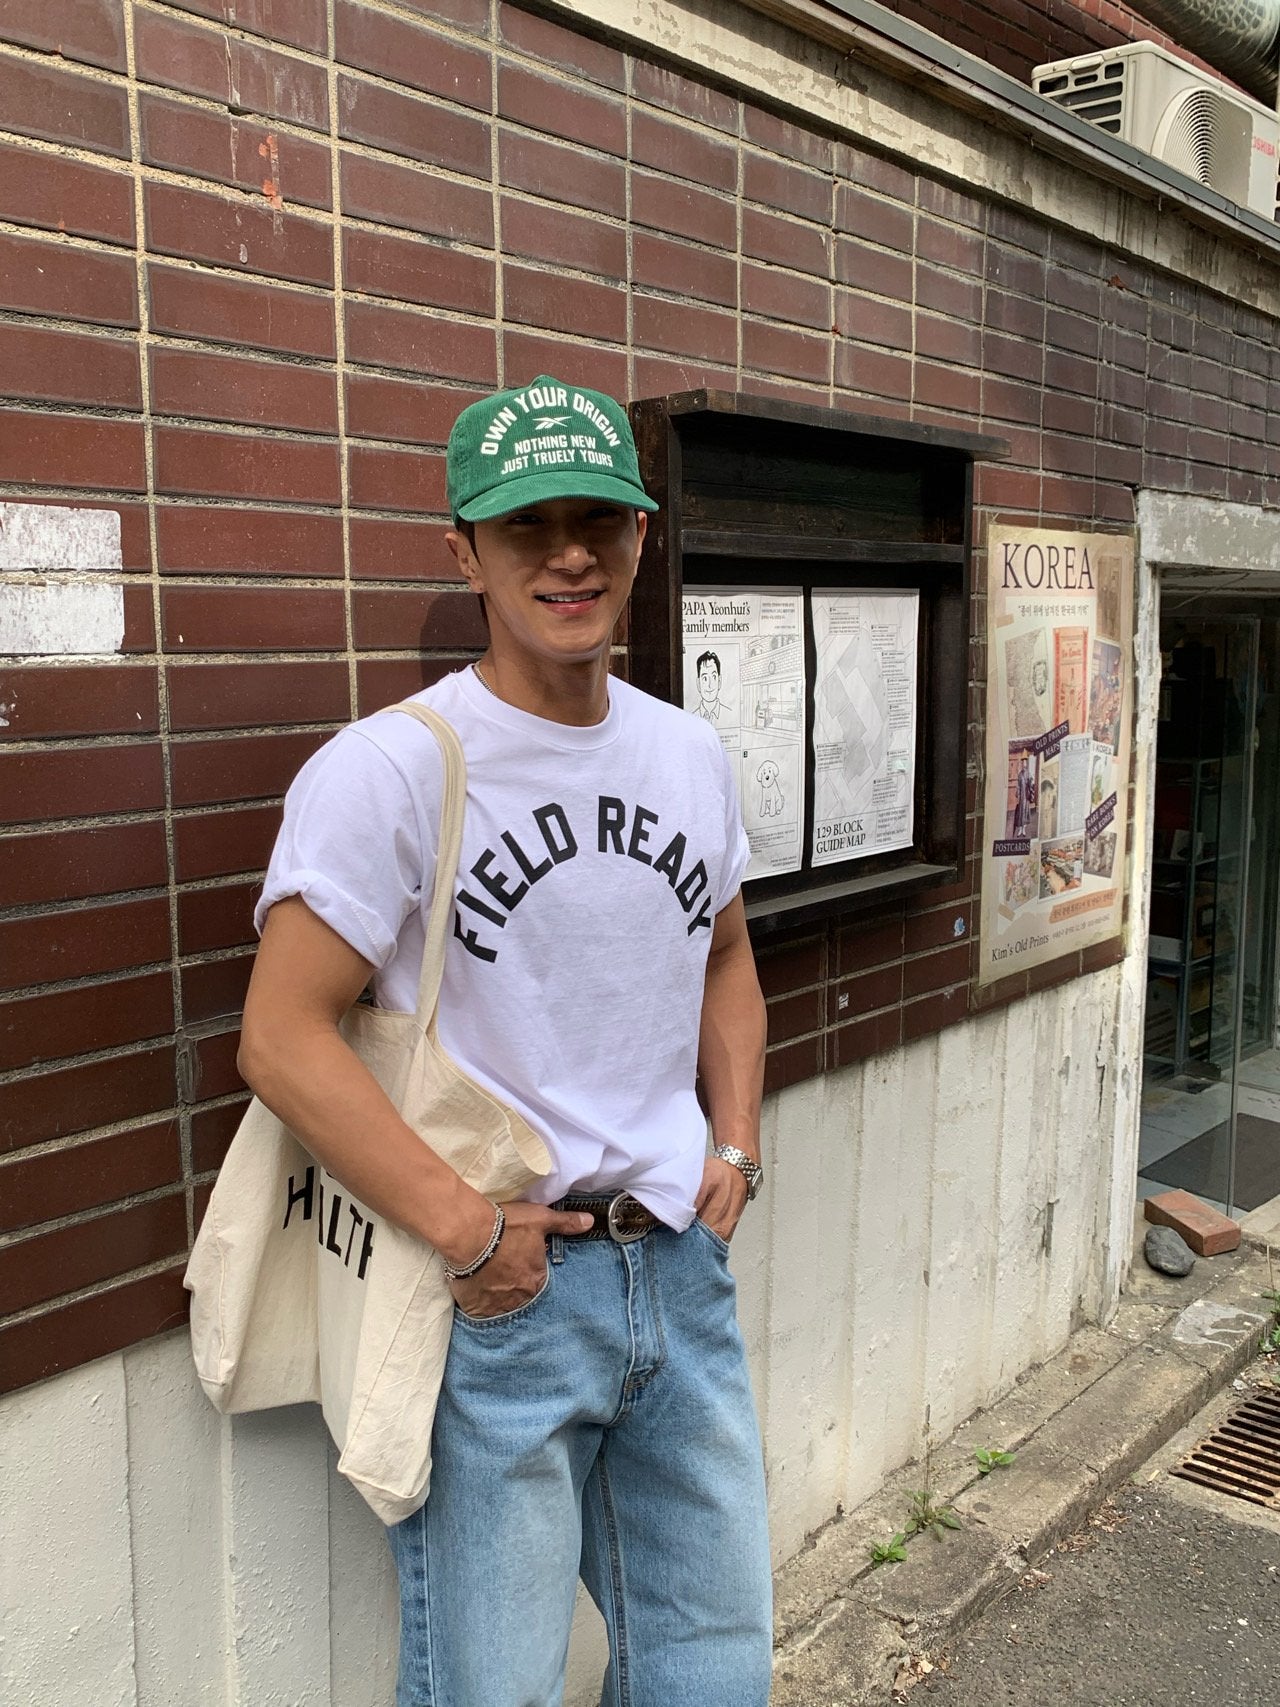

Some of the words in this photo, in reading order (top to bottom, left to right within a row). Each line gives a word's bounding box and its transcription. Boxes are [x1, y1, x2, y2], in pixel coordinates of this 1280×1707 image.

[481, 407, 518, 455] OWN
[514, 387, 568, 413] YOUR
[573, 393, 621, 447] ORIGIN
[515, 435, 568, 455] NOTHING
[571, 434, 596, 449] NEW
[501, 457, 529, 475] JUST
[533, 451, 576, 465] TRUELY
[580, 452, 613, 468] YOURS
[1001, 543, 1095, 589] KOREA
[711, 618, 750, 633] members
[1035, 736, 1048, 750] OLD
[1048, 724, 1068, 742] PRINTS
[1045, 742, 1060, 757] MAPS
[816, 826, 832, 838] 129
[833, 819, 864, 836] BLOCK
[816, 837, 845, 854] GUIDE
[847, 833, 866, 848] MAP
[995, 842, 1030, 853] POSTCARDS
[453, 802, 578, 963] FIELD
[598, 795, 712, 936] READY
[991, 942, 1014, 962] Kim's
[1014, 938, 1028, 954] Old
[1029, 934, 1050, 949] Prints
